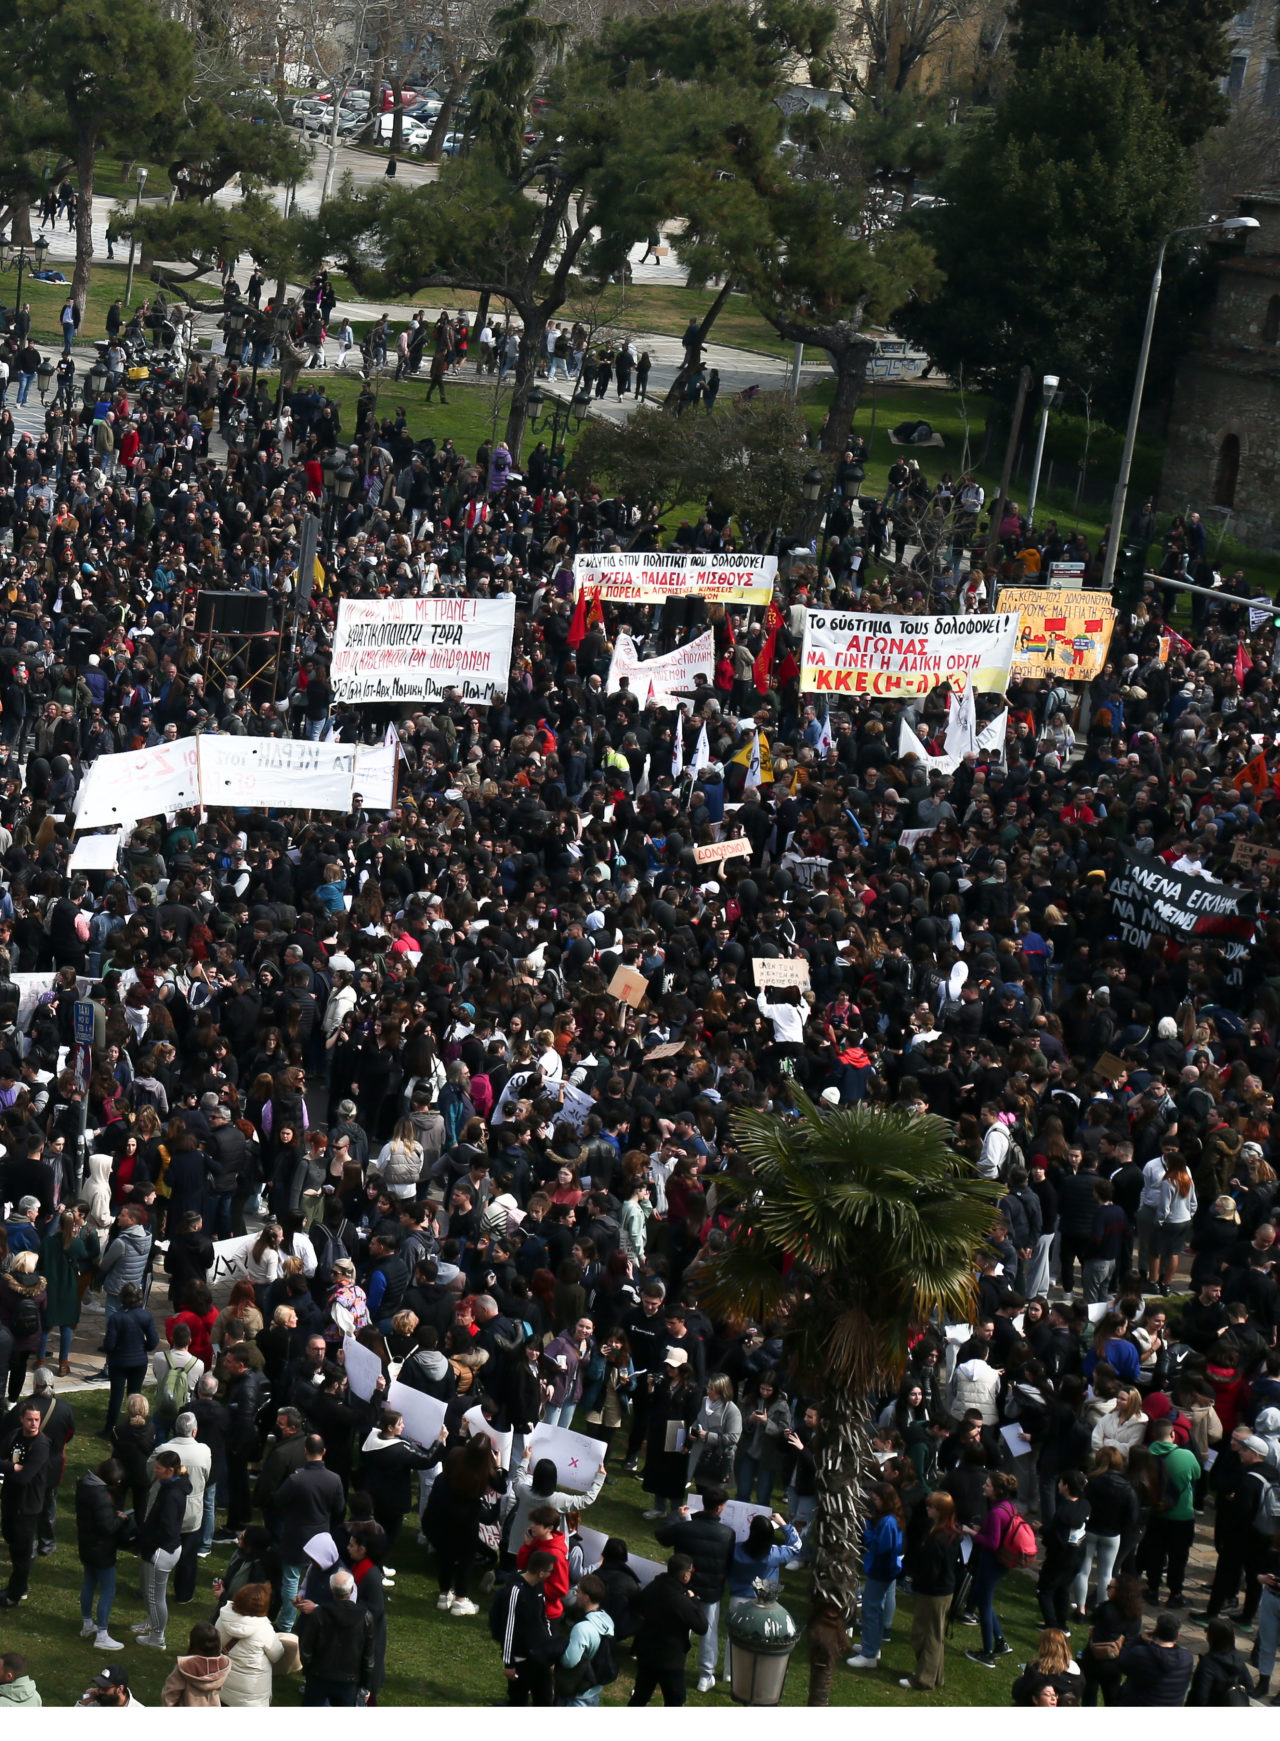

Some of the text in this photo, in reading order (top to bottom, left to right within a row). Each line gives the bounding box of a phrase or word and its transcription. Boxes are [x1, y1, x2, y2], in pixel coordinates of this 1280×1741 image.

[598, 571, 633, 585] ΥΓΕΙΑ
[641, 571, 687, 586] ΠΑΙΔΕΙΑ
[696, 571, 754, 587] ΜΙΣΘΟΥΣ
[605, 585, 642, 599] ΠΟΡΕΙΑ
[431, 624, 463, 646] ΤΩΡΑ
[846, 635, 929, 656] ΑΓΩΝΑΣ
[806, 651, 826, 666] ΝΑ
[835, 651, 874, 670] ΓΙΝΕΙ
[880, 656, 891, 671] Η
[946, 654, 982, 670] ΟΡΓΗ
[1111, 897, 1136, 923] ΝΑ
[1119, 921, 1152, 951] ΤΟΝ
